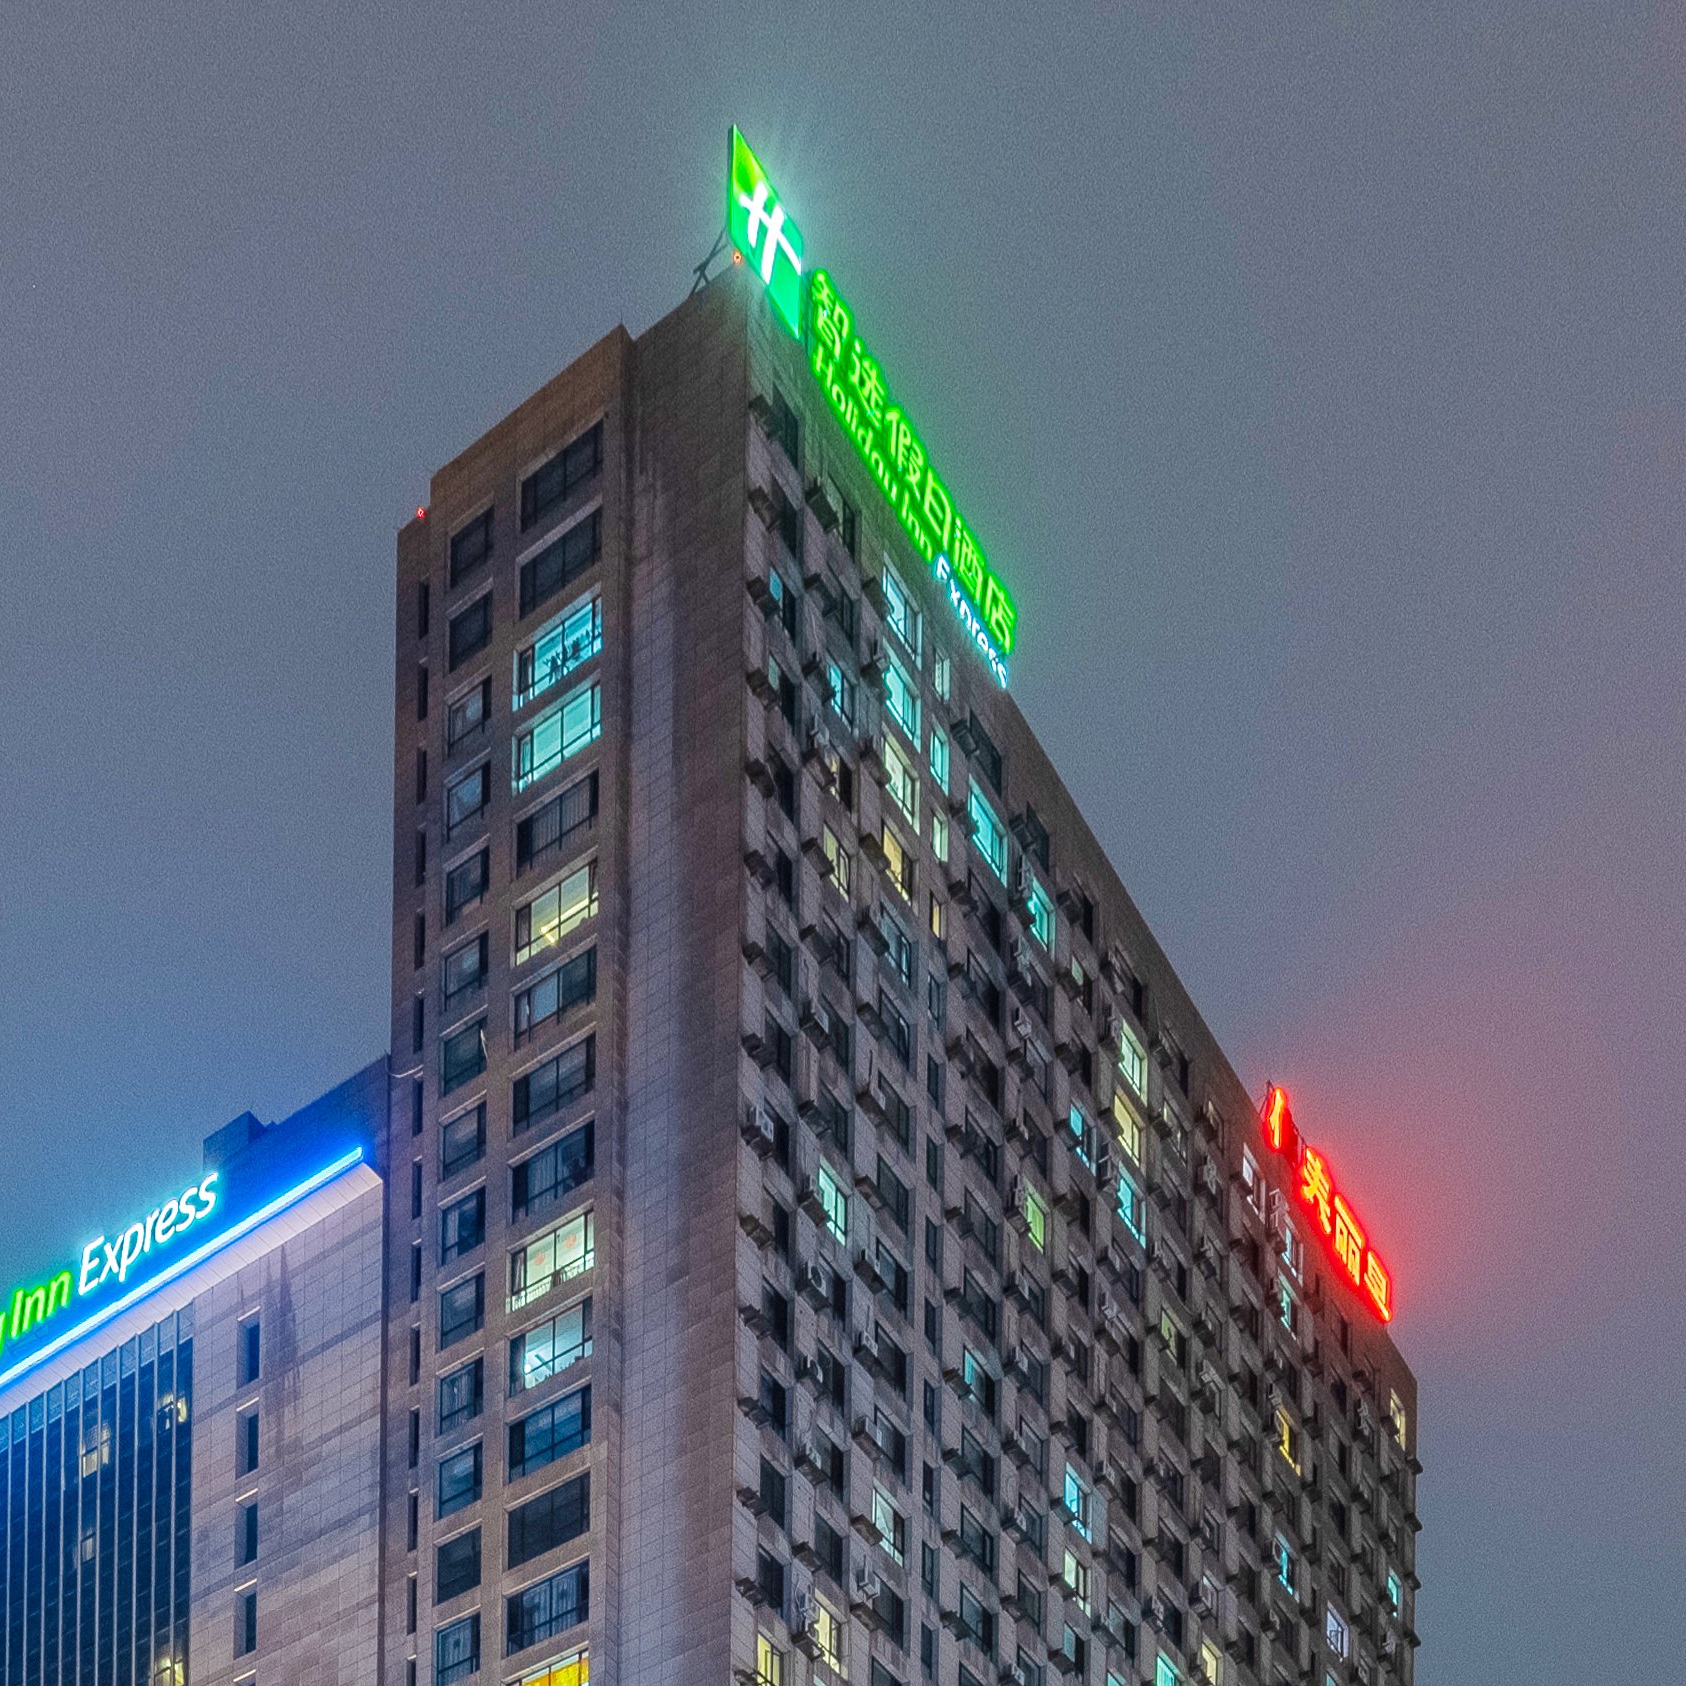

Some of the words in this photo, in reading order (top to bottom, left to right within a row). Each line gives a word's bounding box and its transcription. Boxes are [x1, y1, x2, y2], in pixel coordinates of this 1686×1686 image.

[811, 269, 1014, 652] 智选假日酒店
[814, 345, 899, 502] Holiday
[900, 497, 932, 562] Inn
[934, 554, 1008, 688] Express
[10, 1270, 71, 1338] Inn
[78, 1173, 218, 1295] Express
